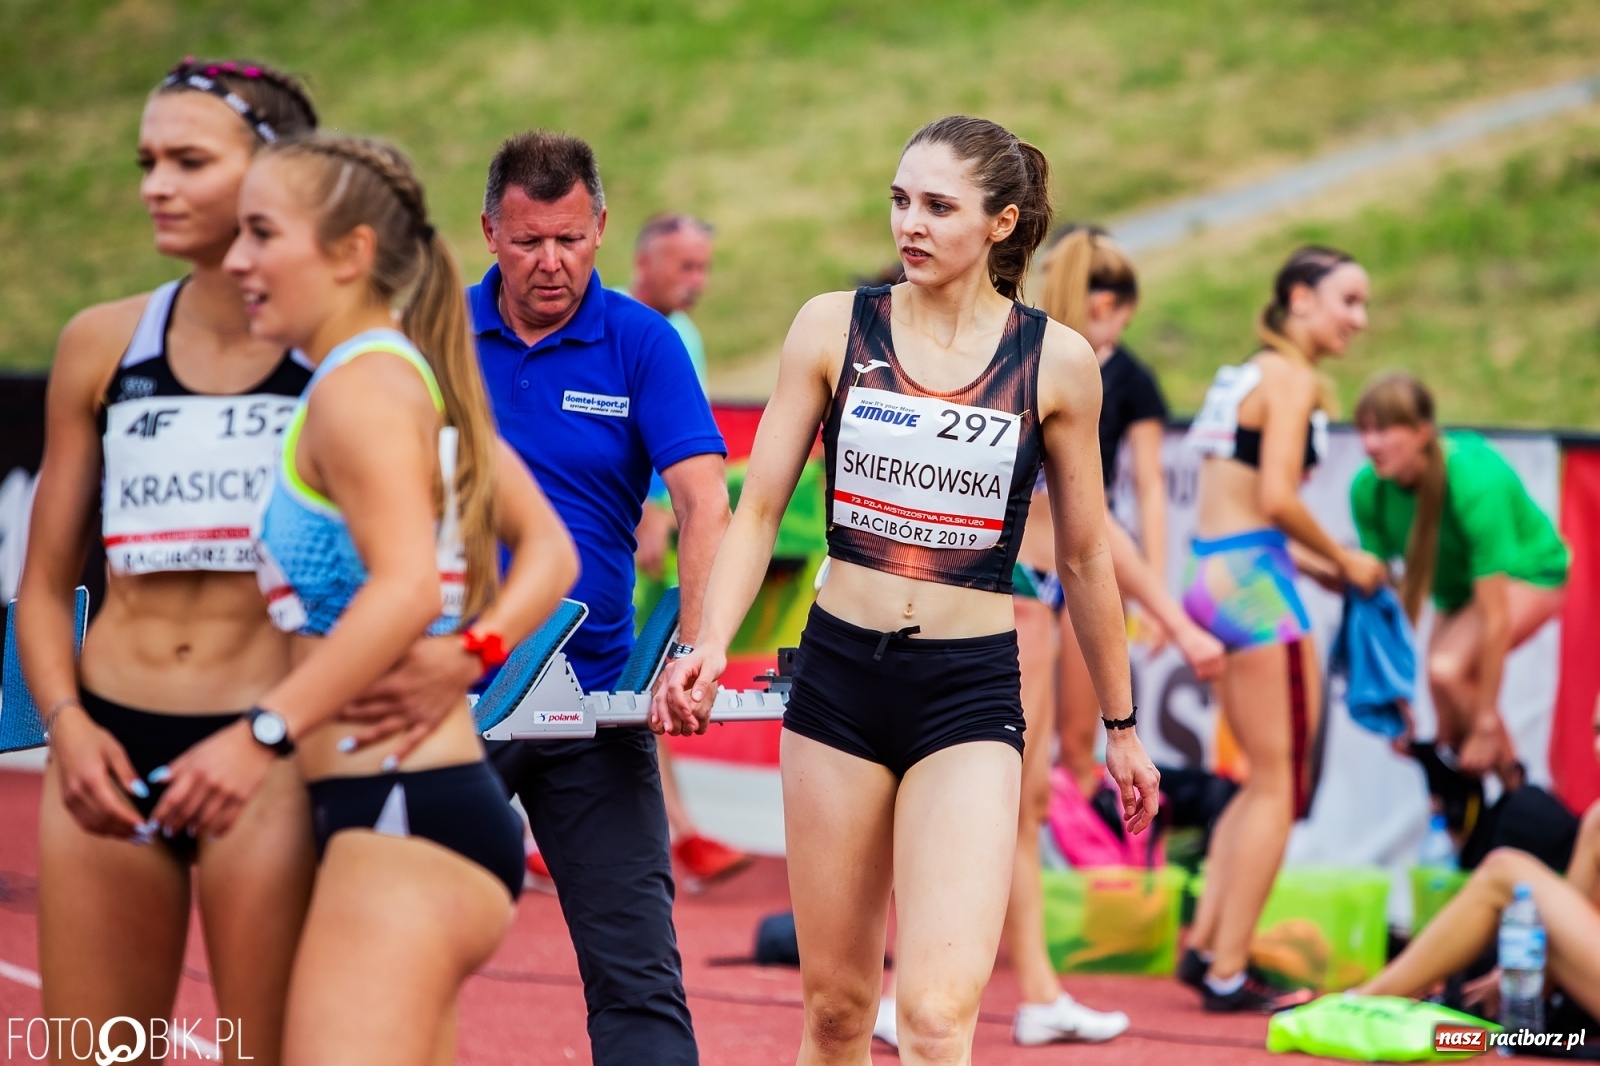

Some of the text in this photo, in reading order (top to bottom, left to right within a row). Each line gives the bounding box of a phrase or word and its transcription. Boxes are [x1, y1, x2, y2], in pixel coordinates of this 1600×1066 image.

[565, 394, 628, 410] domtel-sport.pl
[851, 405, 1012, 447] 4MOVE 297
[120, 466, 268, 509] KRASICK
[843, 449, 1001, 500] SKIERKOWSKA
[851, 510, 977, 547] RACIBÓRZ 2019
[863, 499, 882, 510] PZLA
[884, 505, 938, 521] MISTRZOSTWA
[940, 515, 967, 524] POLSKI
[968, 519, 985, 527] U20
[548, 713, 580, 722] polanik
